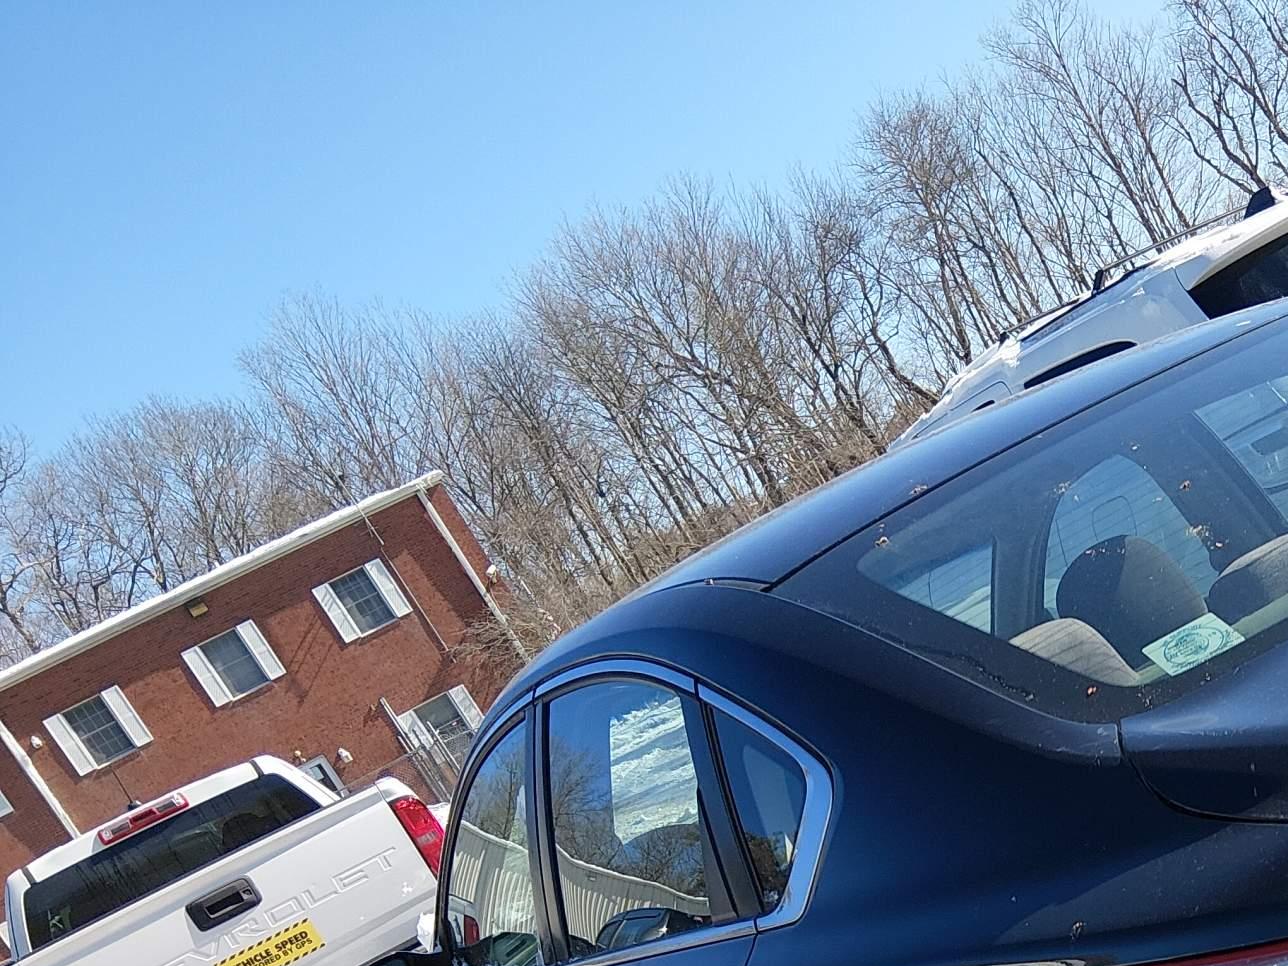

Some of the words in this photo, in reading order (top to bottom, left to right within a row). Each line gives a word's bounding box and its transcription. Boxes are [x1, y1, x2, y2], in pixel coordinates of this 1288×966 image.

[275, 930, 309, 952] SPEED
[282, 946, 294, 957] BY
[295, 937, 313, 950] GPS
